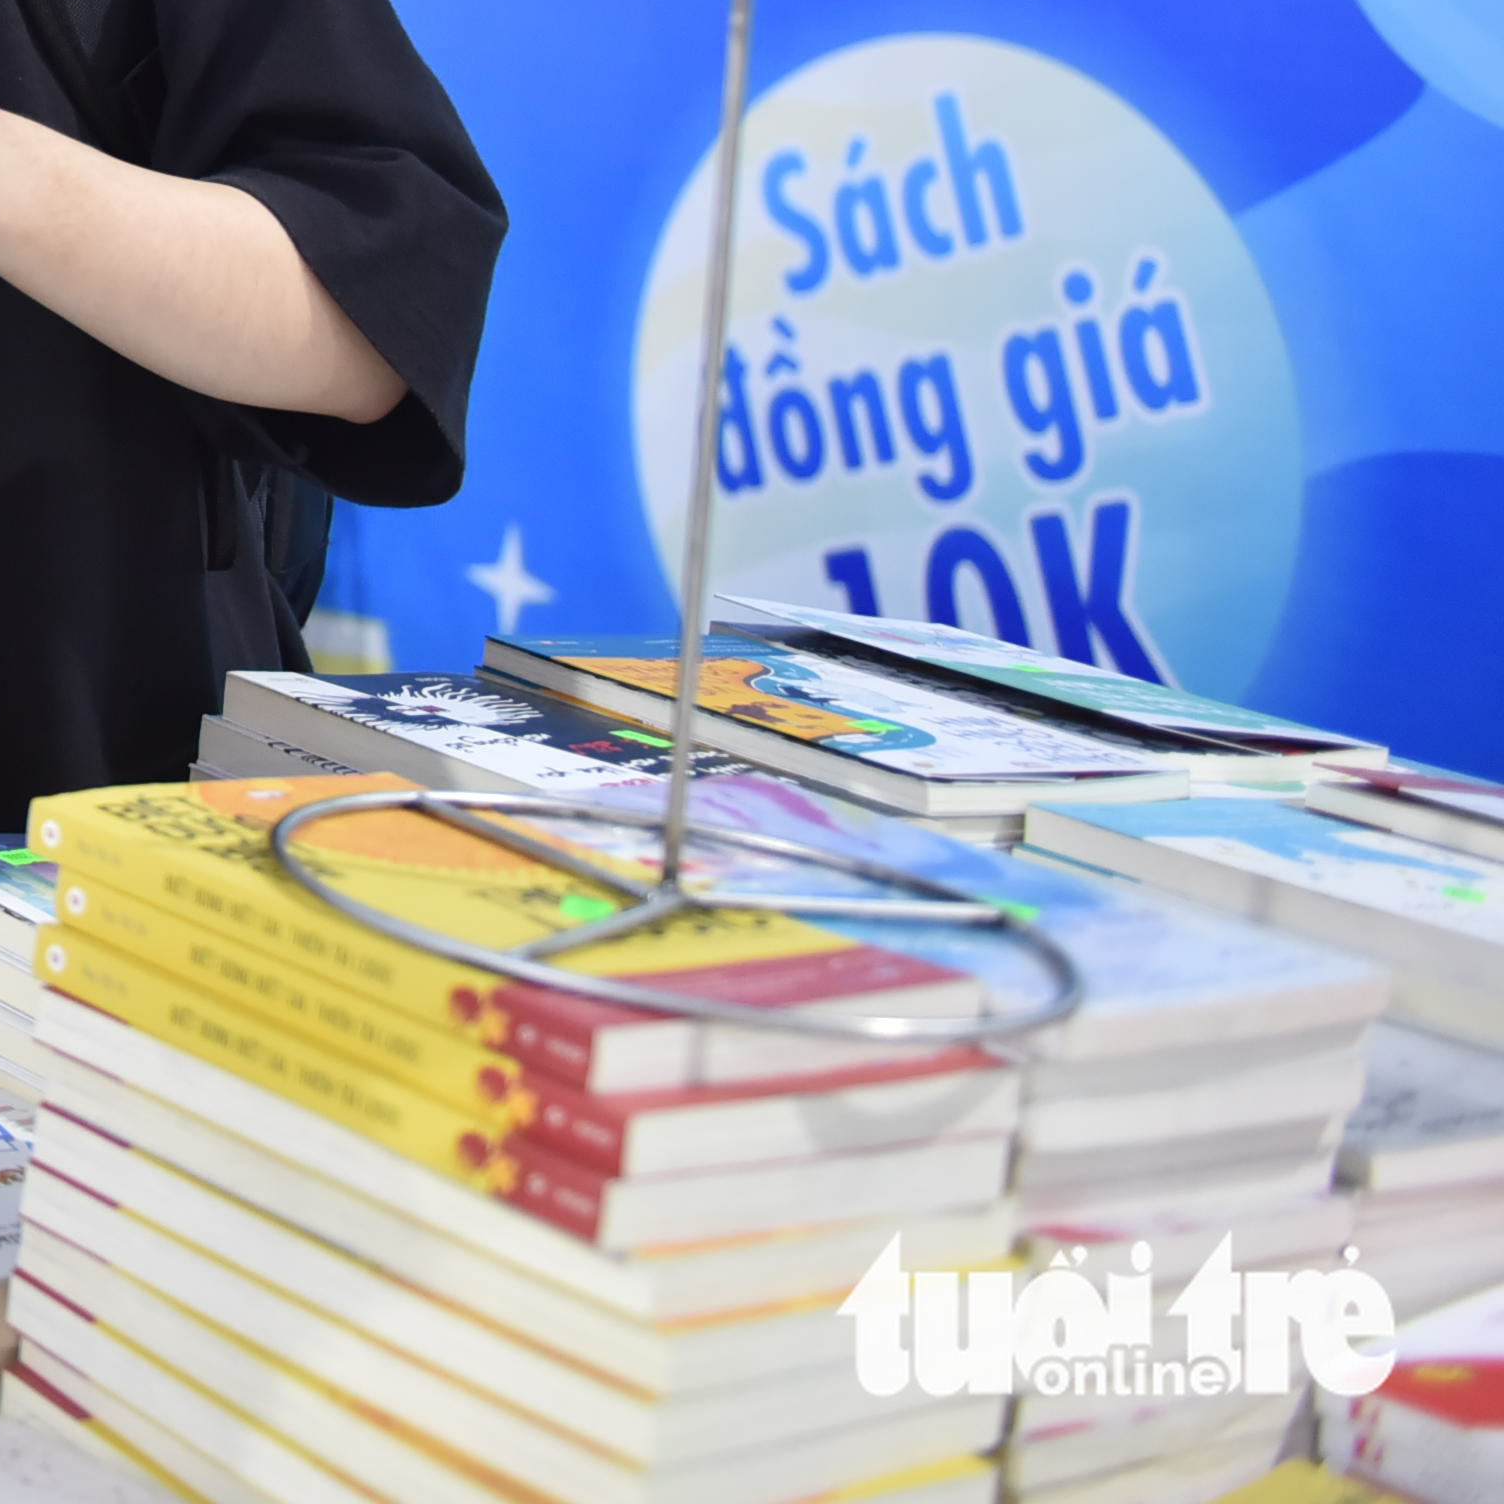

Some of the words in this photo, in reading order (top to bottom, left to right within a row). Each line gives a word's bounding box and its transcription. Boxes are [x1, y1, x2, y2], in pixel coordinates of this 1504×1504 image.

[761, 90, 1025, 294] Sách
[713, 316, 974, 502] đồng
[1000, 256, 1200, 482] giá
